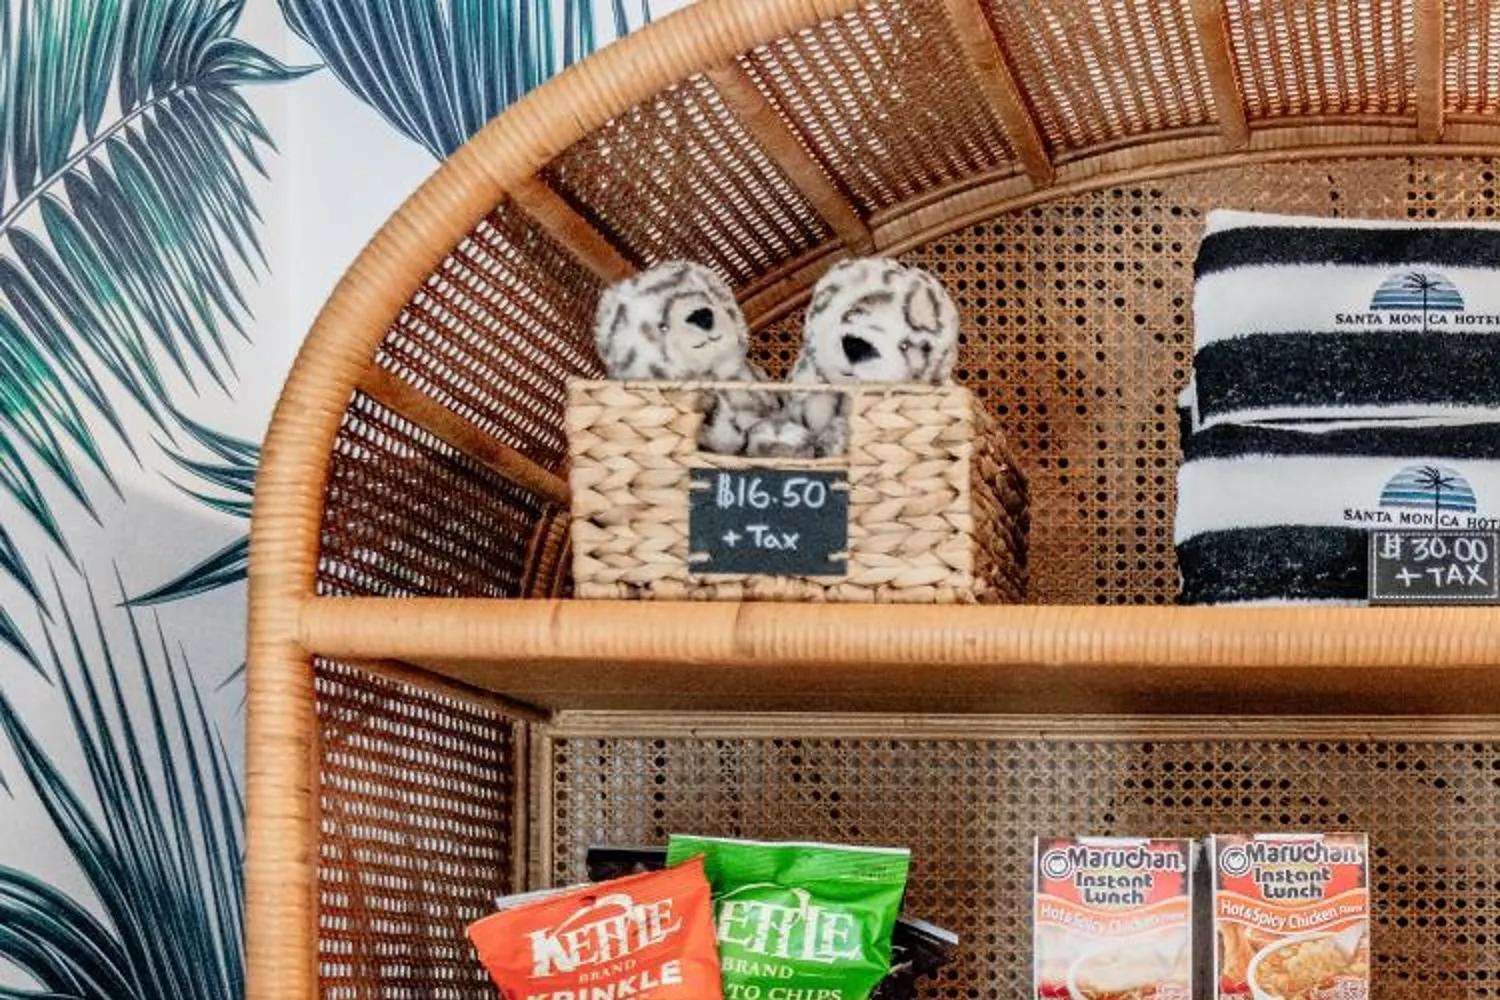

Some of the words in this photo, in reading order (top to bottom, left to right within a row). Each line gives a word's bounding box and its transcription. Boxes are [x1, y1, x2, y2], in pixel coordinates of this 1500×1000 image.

[1335, 313, 1382, 325] SANTA
[716, 473, 826, 509] $16.50
[1344, 509, 1392, 523] SANTA
[1068, 843, 1180, 869] Maruchan
[1246, 842, 1357, 864] Maruchan
[1076, 872, 1152, 889] Instant
[1255, 867, 1330, 884] Instant
[1084, 888, 1144, 904] Lunch
[1264, 883, 1322, 898] Lunch
[1289, 906, 1338, 928] Chicken
[522, 895, 683, 979] KETTLE
[579, 959, 637, 984] BRAND
[722, 957, 793, 979] BRAND
